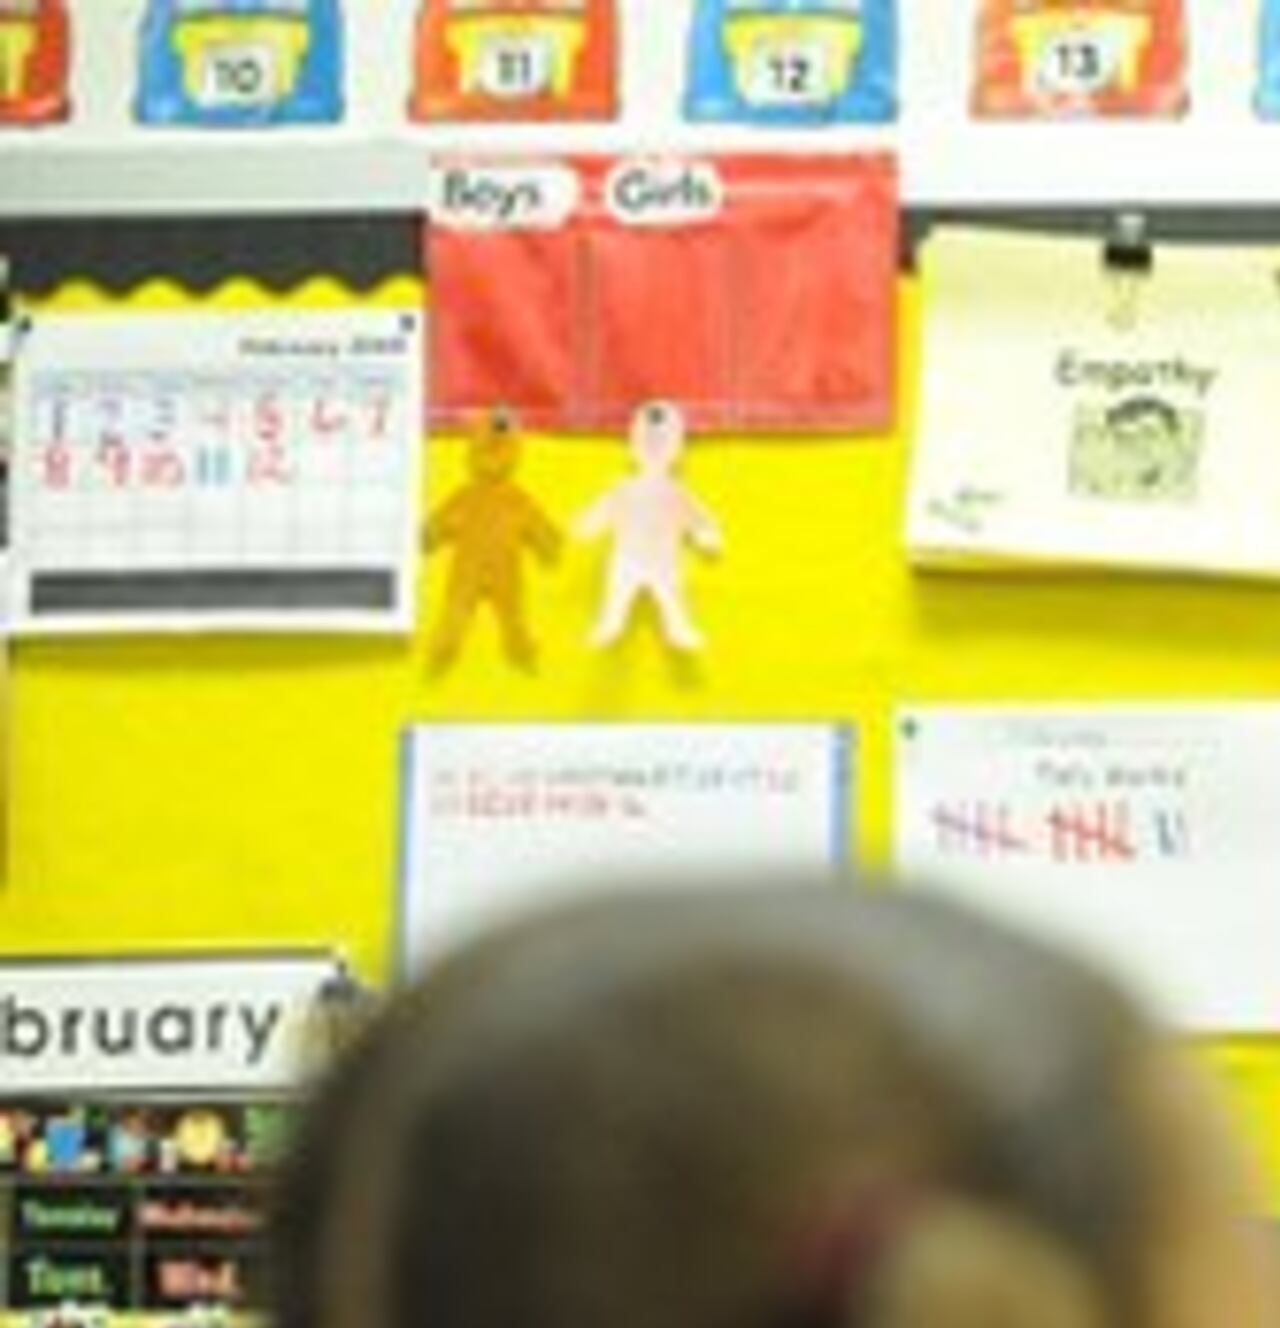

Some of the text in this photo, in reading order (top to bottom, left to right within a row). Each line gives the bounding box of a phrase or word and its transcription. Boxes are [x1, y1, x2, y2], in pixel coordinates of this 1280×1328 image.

[211, 60, 262, 95] 10
[496, 50, 533, 84] 11
[769, 58, 809, 93] 12
[1052, 42, 1100, 80] 13
[443, 172, 717, 217] Boys Girls
[1053, 347, 1219, 397] Empathy
[2, 993, 281, 1066] bruary
